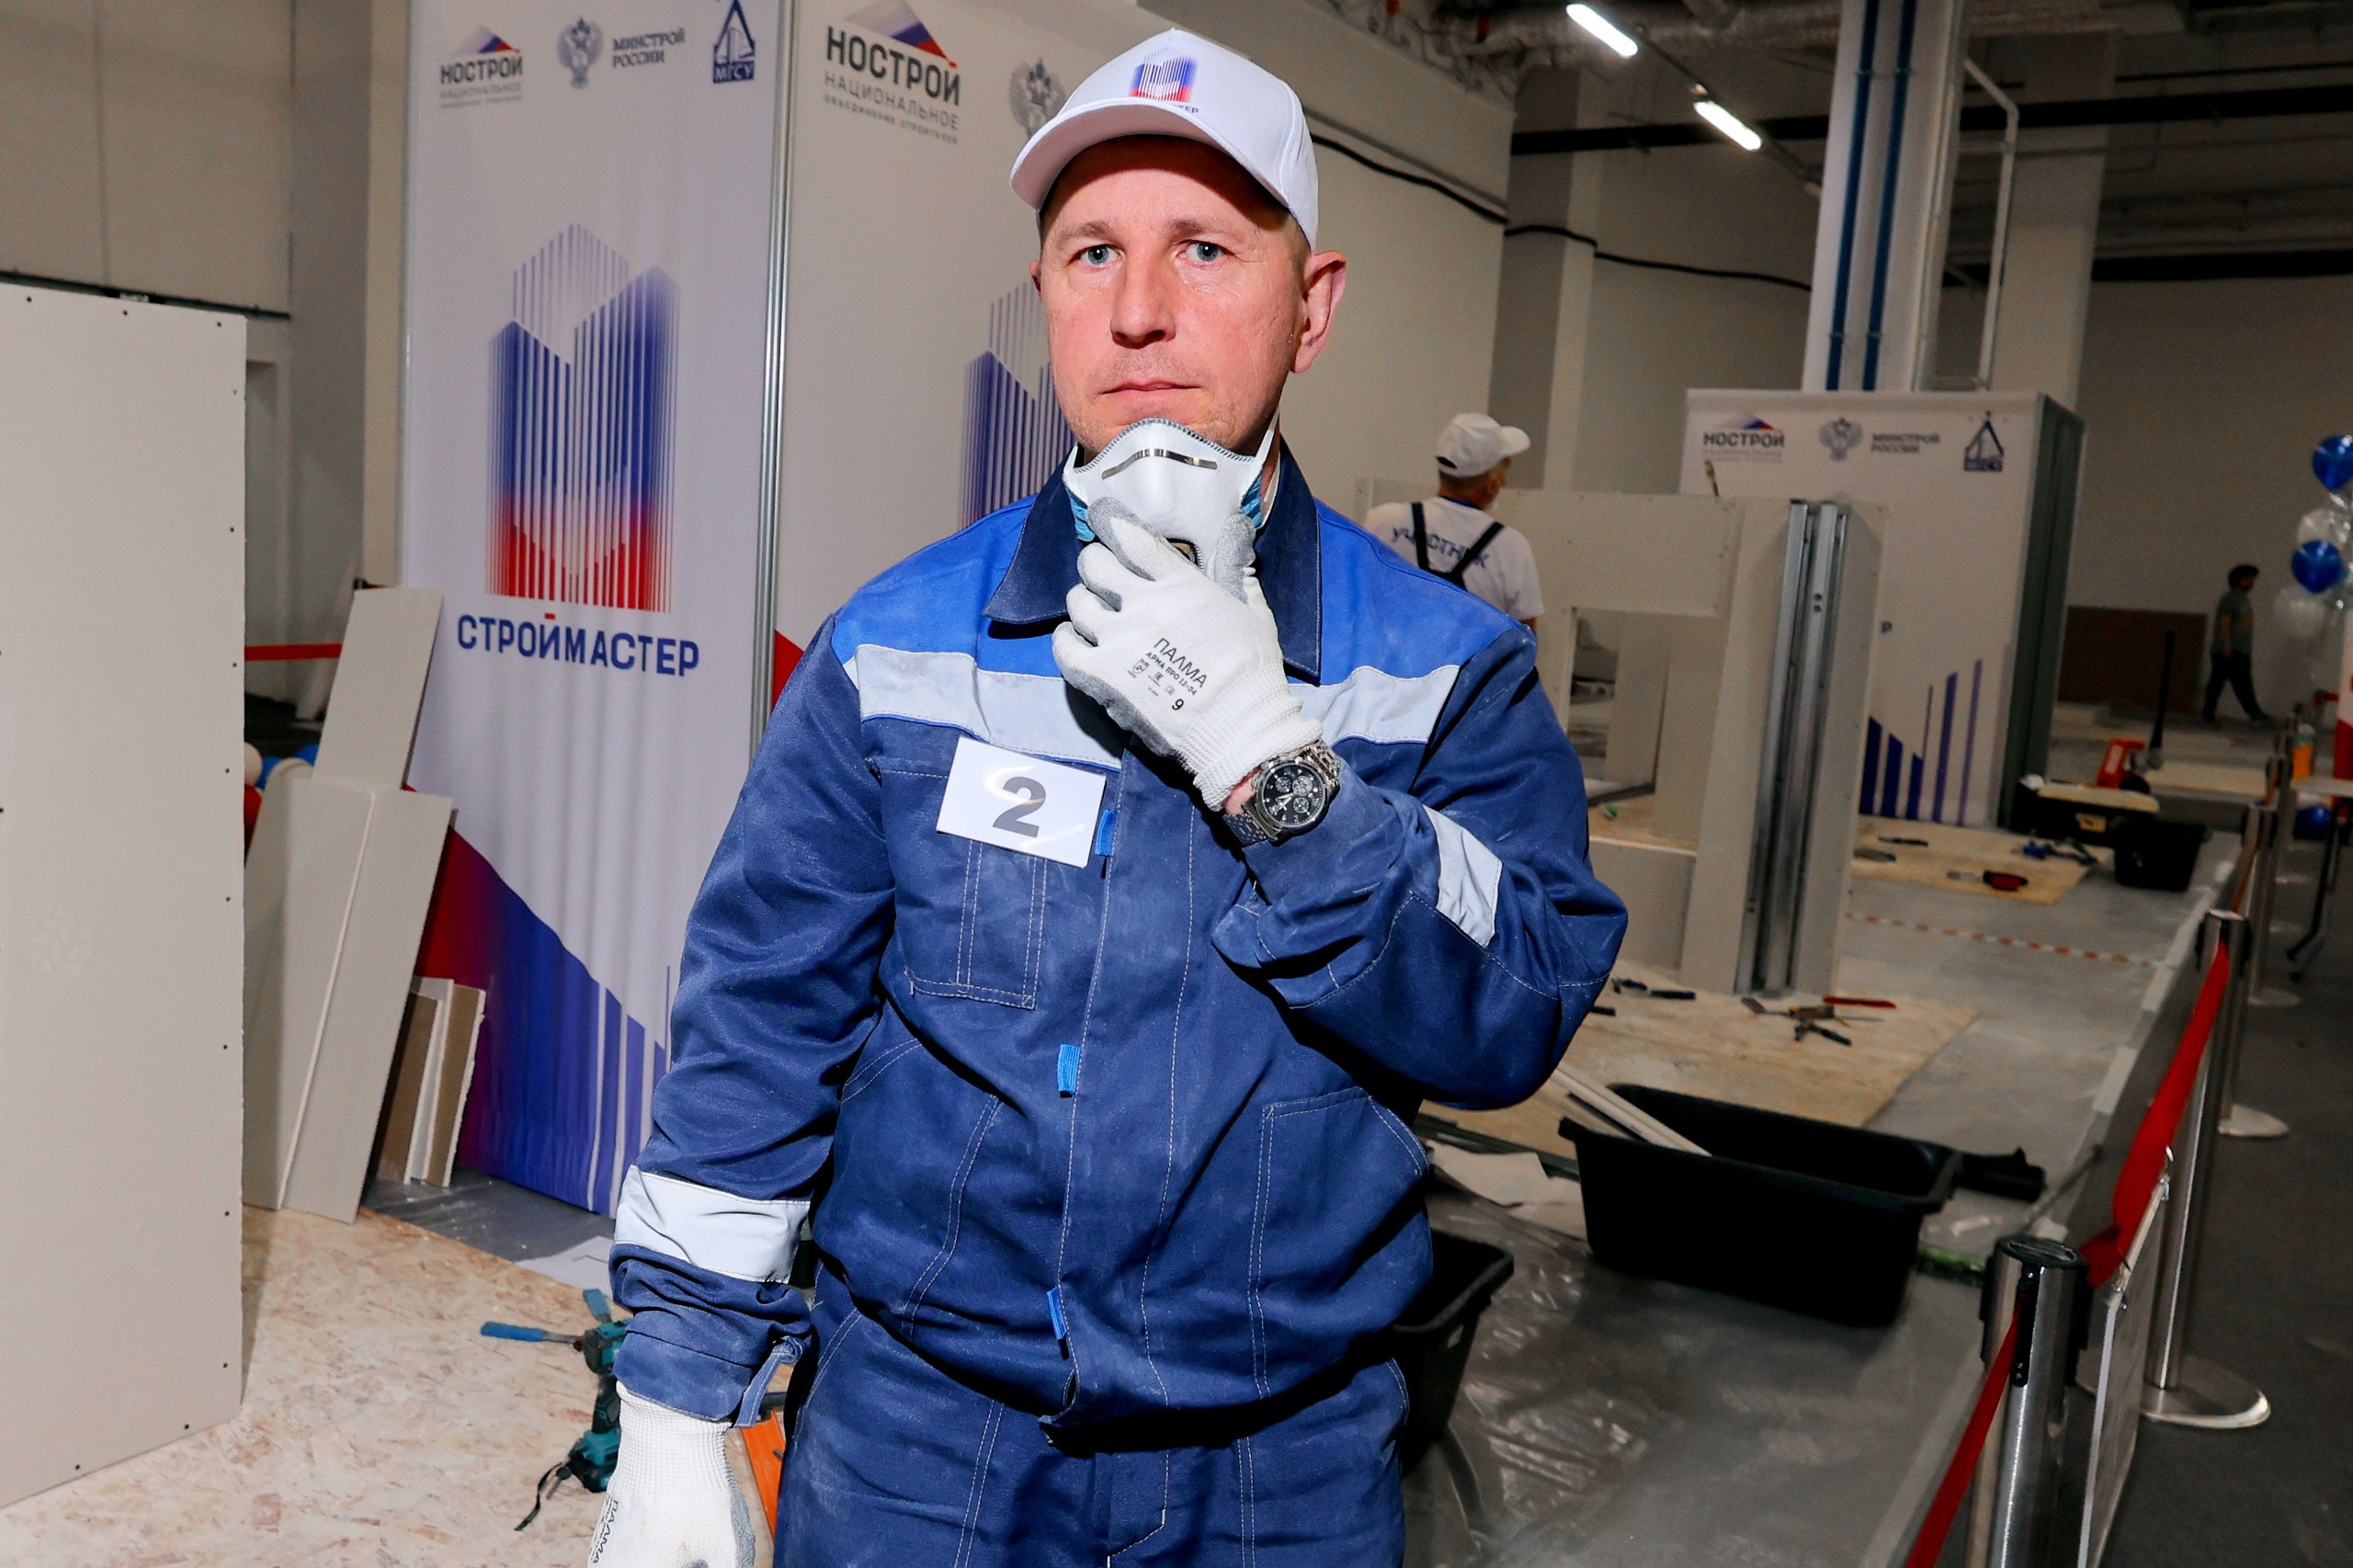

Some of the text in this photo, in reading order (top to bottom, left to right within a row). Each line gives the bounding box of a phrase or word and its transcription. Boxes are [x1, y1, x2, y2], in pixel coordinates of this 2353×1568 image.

[612, 51, 665, 69] РОССИИ
[613, 27, 686, 51] МИНСТРОЙ
[824, 69, 960, 131] НАЦИОНАЛЬНОЕ
[1391, 527, 1490, 569] УЧСТНК
[457, 613, 700, 677] СТРОЙМАСТЕР
[1145, 652, 1165, 669] АРМА
[1165, 666, 1180, 680] ПРО
[1154, 637, 1208, 688] ПАЛМА
[1171, 699, 1185, 711] 9
[993, 776, 1047, 838] 2
[593, 1499, 619, 1564] ПАЛМА
